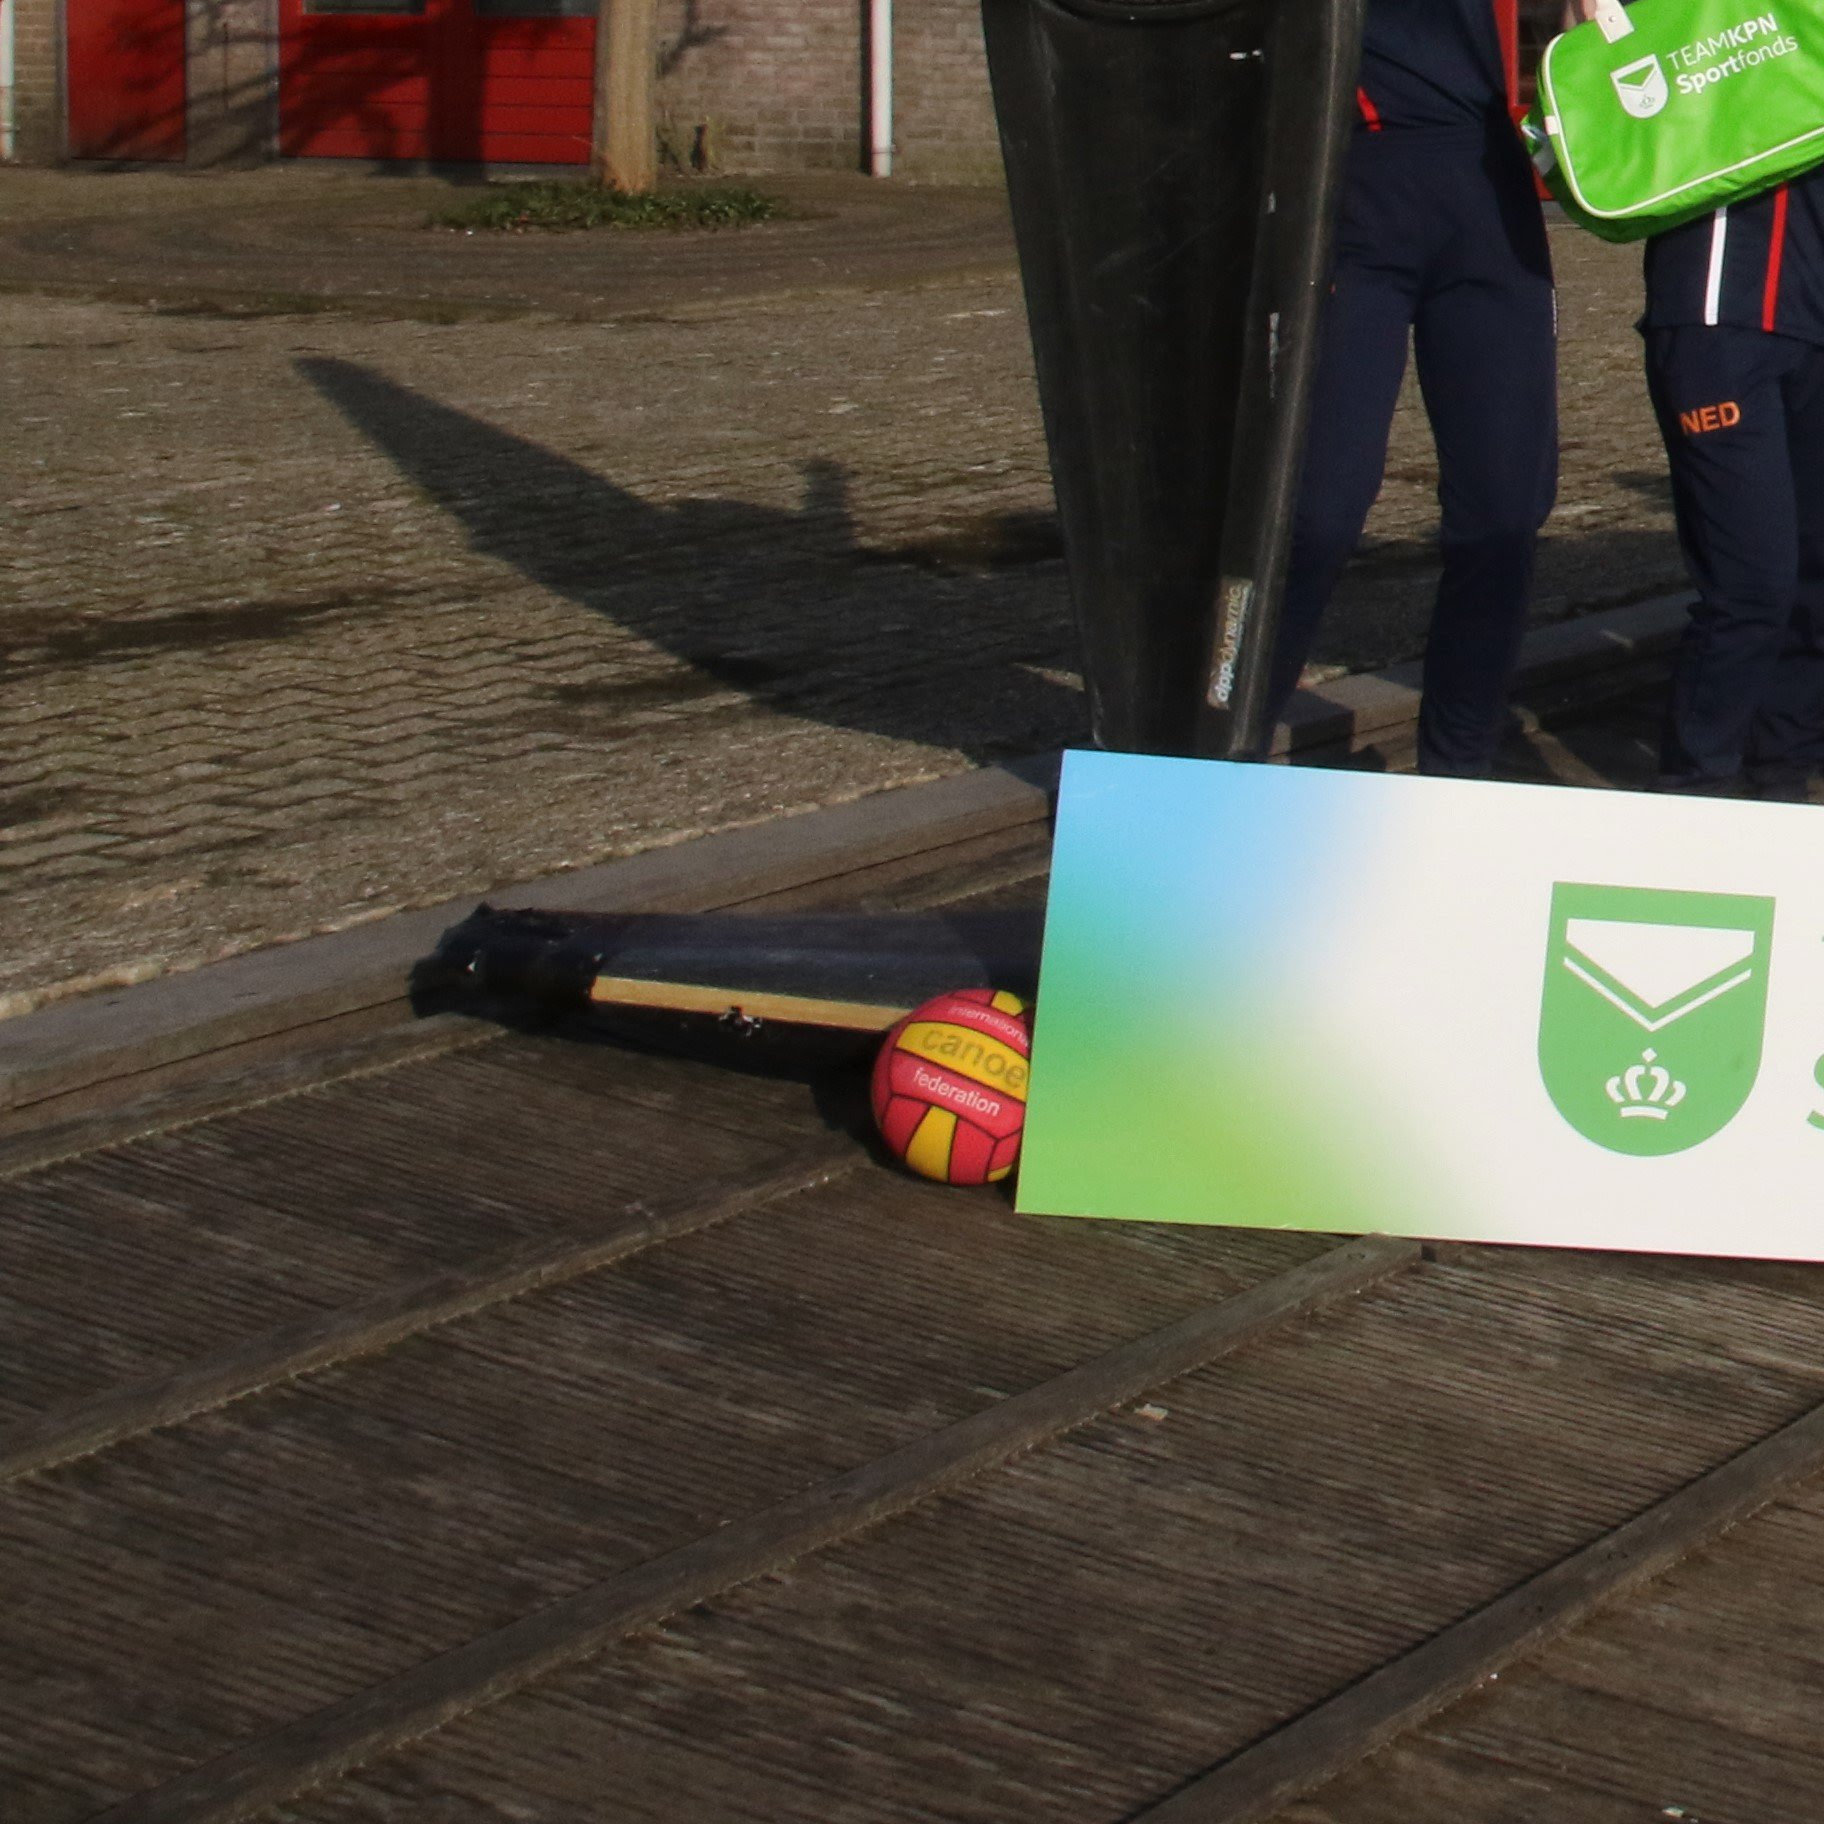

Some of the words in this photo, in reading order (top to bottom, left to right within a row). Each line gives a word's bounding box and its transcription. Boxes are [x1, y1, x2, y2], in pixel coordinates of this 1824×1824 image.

[1666, 12, 1779, 70] TEAMKPN
[1675, 35, 1799, 95] Sportfonds
[1680, 401, 1742, 434] NED
[922, 1030, 1026, 1089] canoe
[914, 1067, 1001, 1117] federation
